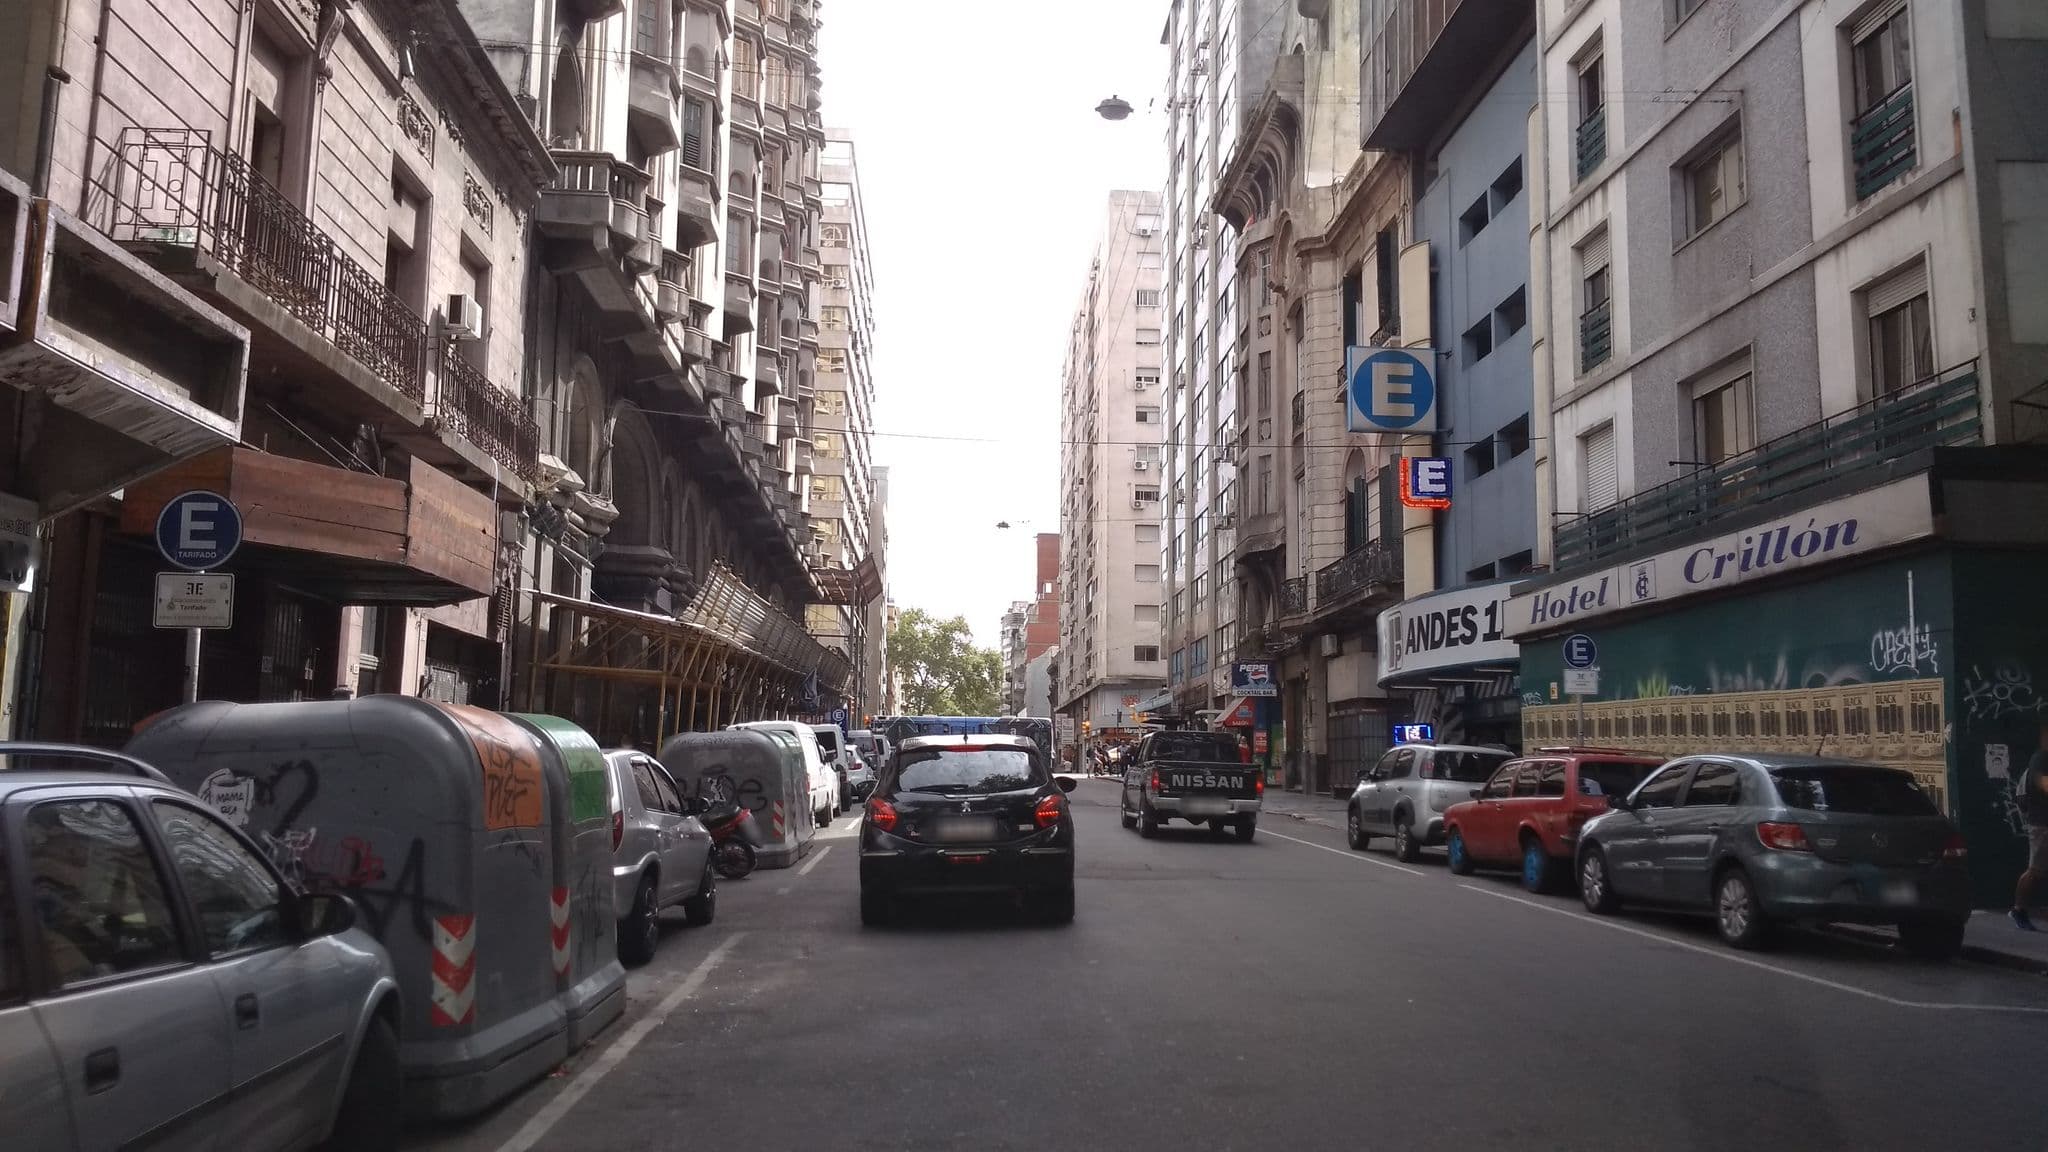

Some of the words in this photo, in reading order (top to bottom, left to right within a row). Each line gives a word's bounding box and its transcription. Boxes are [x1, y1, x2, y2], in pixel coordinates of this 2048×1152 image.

[1372, 362, 1415, 417] E
[1418, 461, 1446, 492] E
[180, 502, 219, 549] E
[178, 551, 217, 559] TARIFADO
[1530, 576, 1608, 625] Hotel
[1683, 518, 1859, 585] Crillón
[1405, 604, 1478, 655] ANDES
[1572, 639, 1589, 660] E
[1239, 664, 1269, 672] PEPSI
[1875, 695, 1897, 705] BLACK
[1910, 691, 1932, 702] BLACK
[1924, 735, 1941, 744] FLAG
[1172, 774, 1244, 789] NISSAN
